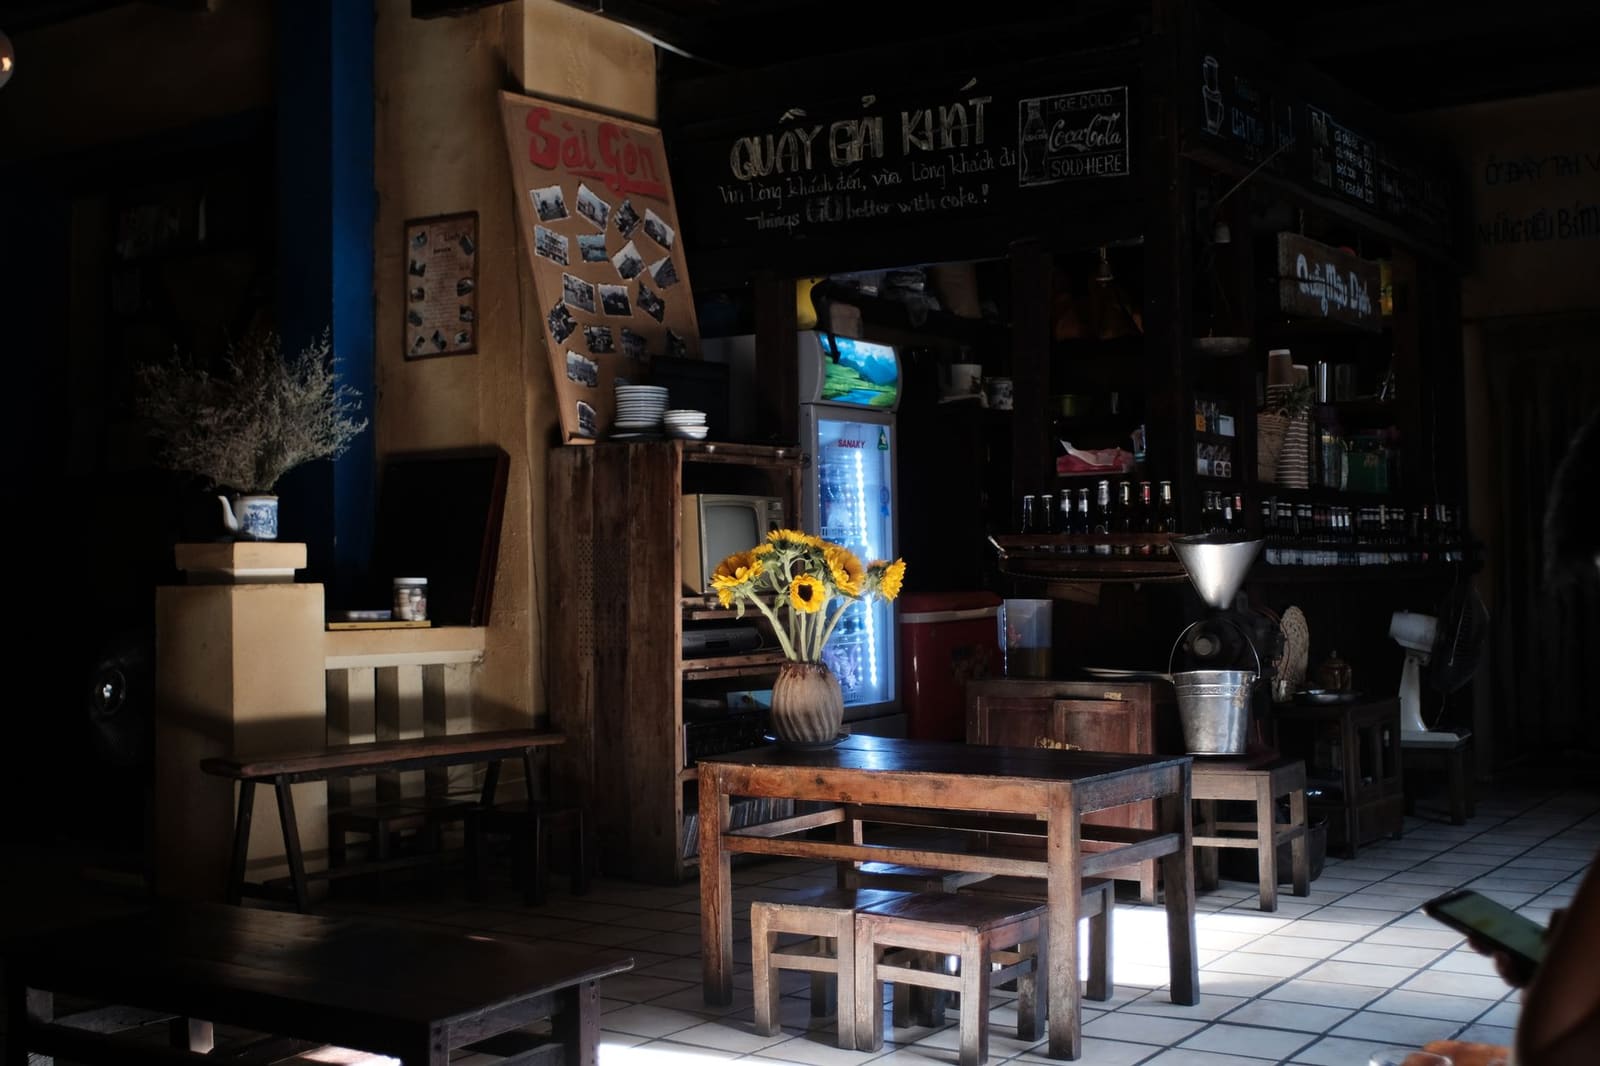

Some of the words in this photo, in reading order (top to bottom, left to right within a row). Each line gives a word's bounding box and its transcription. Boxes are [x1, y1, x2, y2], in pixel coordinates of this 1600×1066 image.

[1080, 94, 1113, 110] COLD
[900, 77, 993, 157] KHÁT
[526, 107, 596, 170] Sài
[598, 122, 661, 192] Gòn
[1051, 158, 1084, 178] SOLD
[1085, 154, 1122, 175] HERE
[897, 192, 936, 214] with
[838, 439, 866, 449] SANAKY
